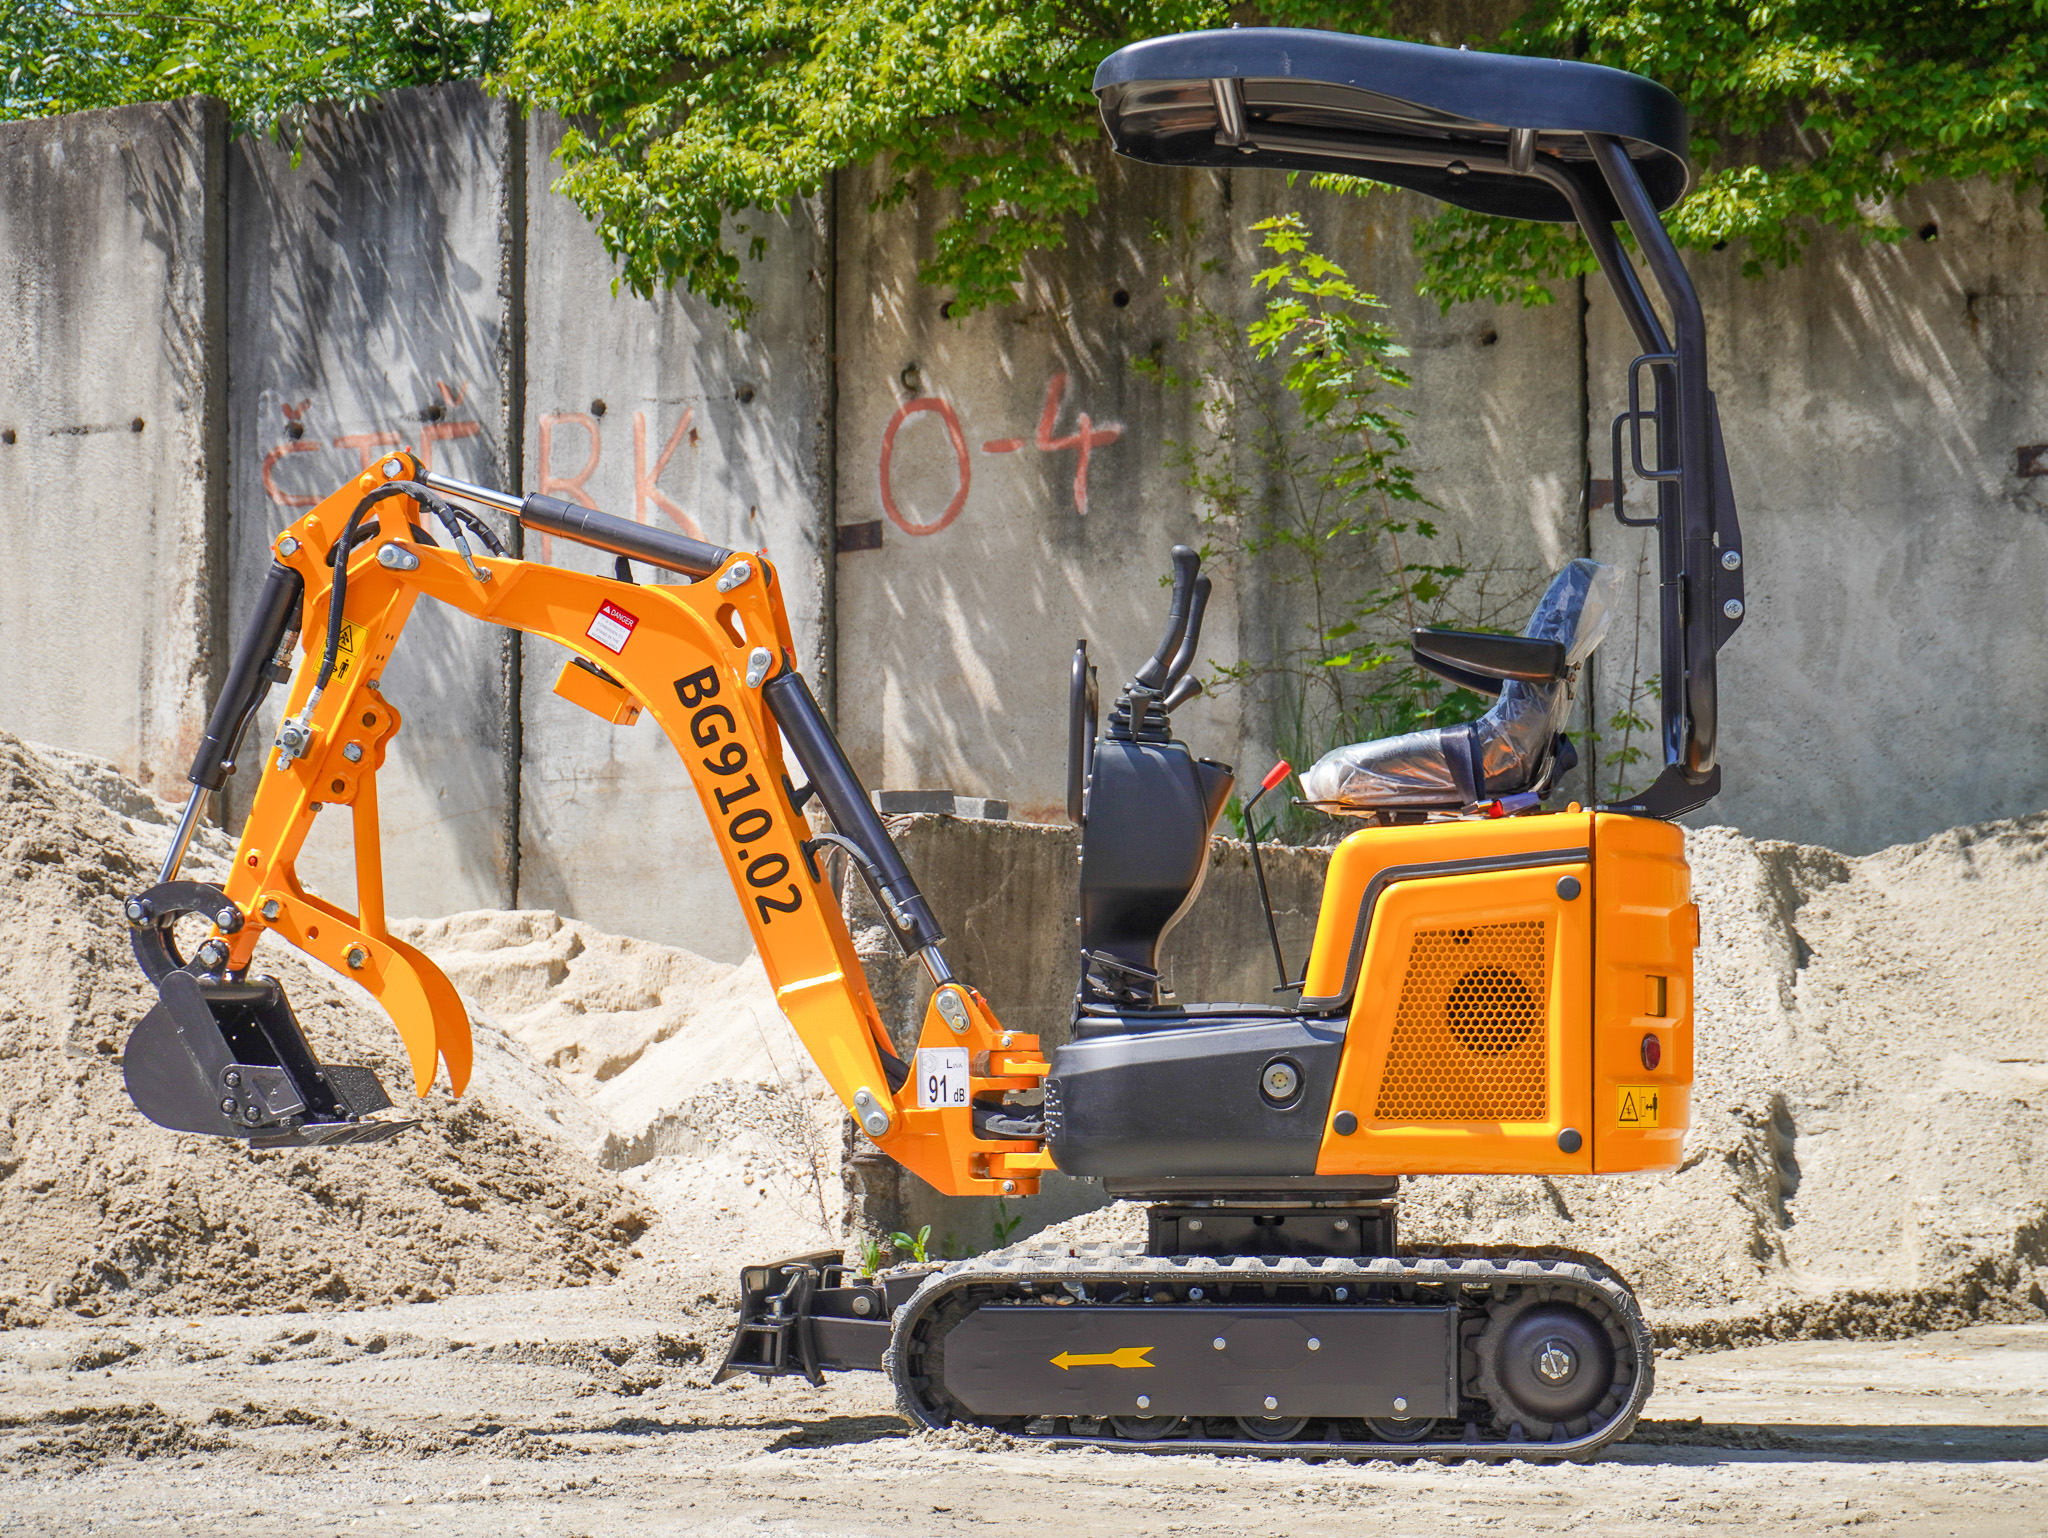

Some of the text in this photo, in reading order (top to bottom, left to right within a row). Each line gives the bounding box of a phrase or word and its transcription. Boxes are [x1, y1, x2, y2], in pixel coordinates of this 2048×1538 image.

[880, 368, 1124, 536] 0-4
[610, 609, 634, 627] DANGER
[673, 665, 802, 925] BG910.02
[929, 1074, 965, 1103] 91 dB
